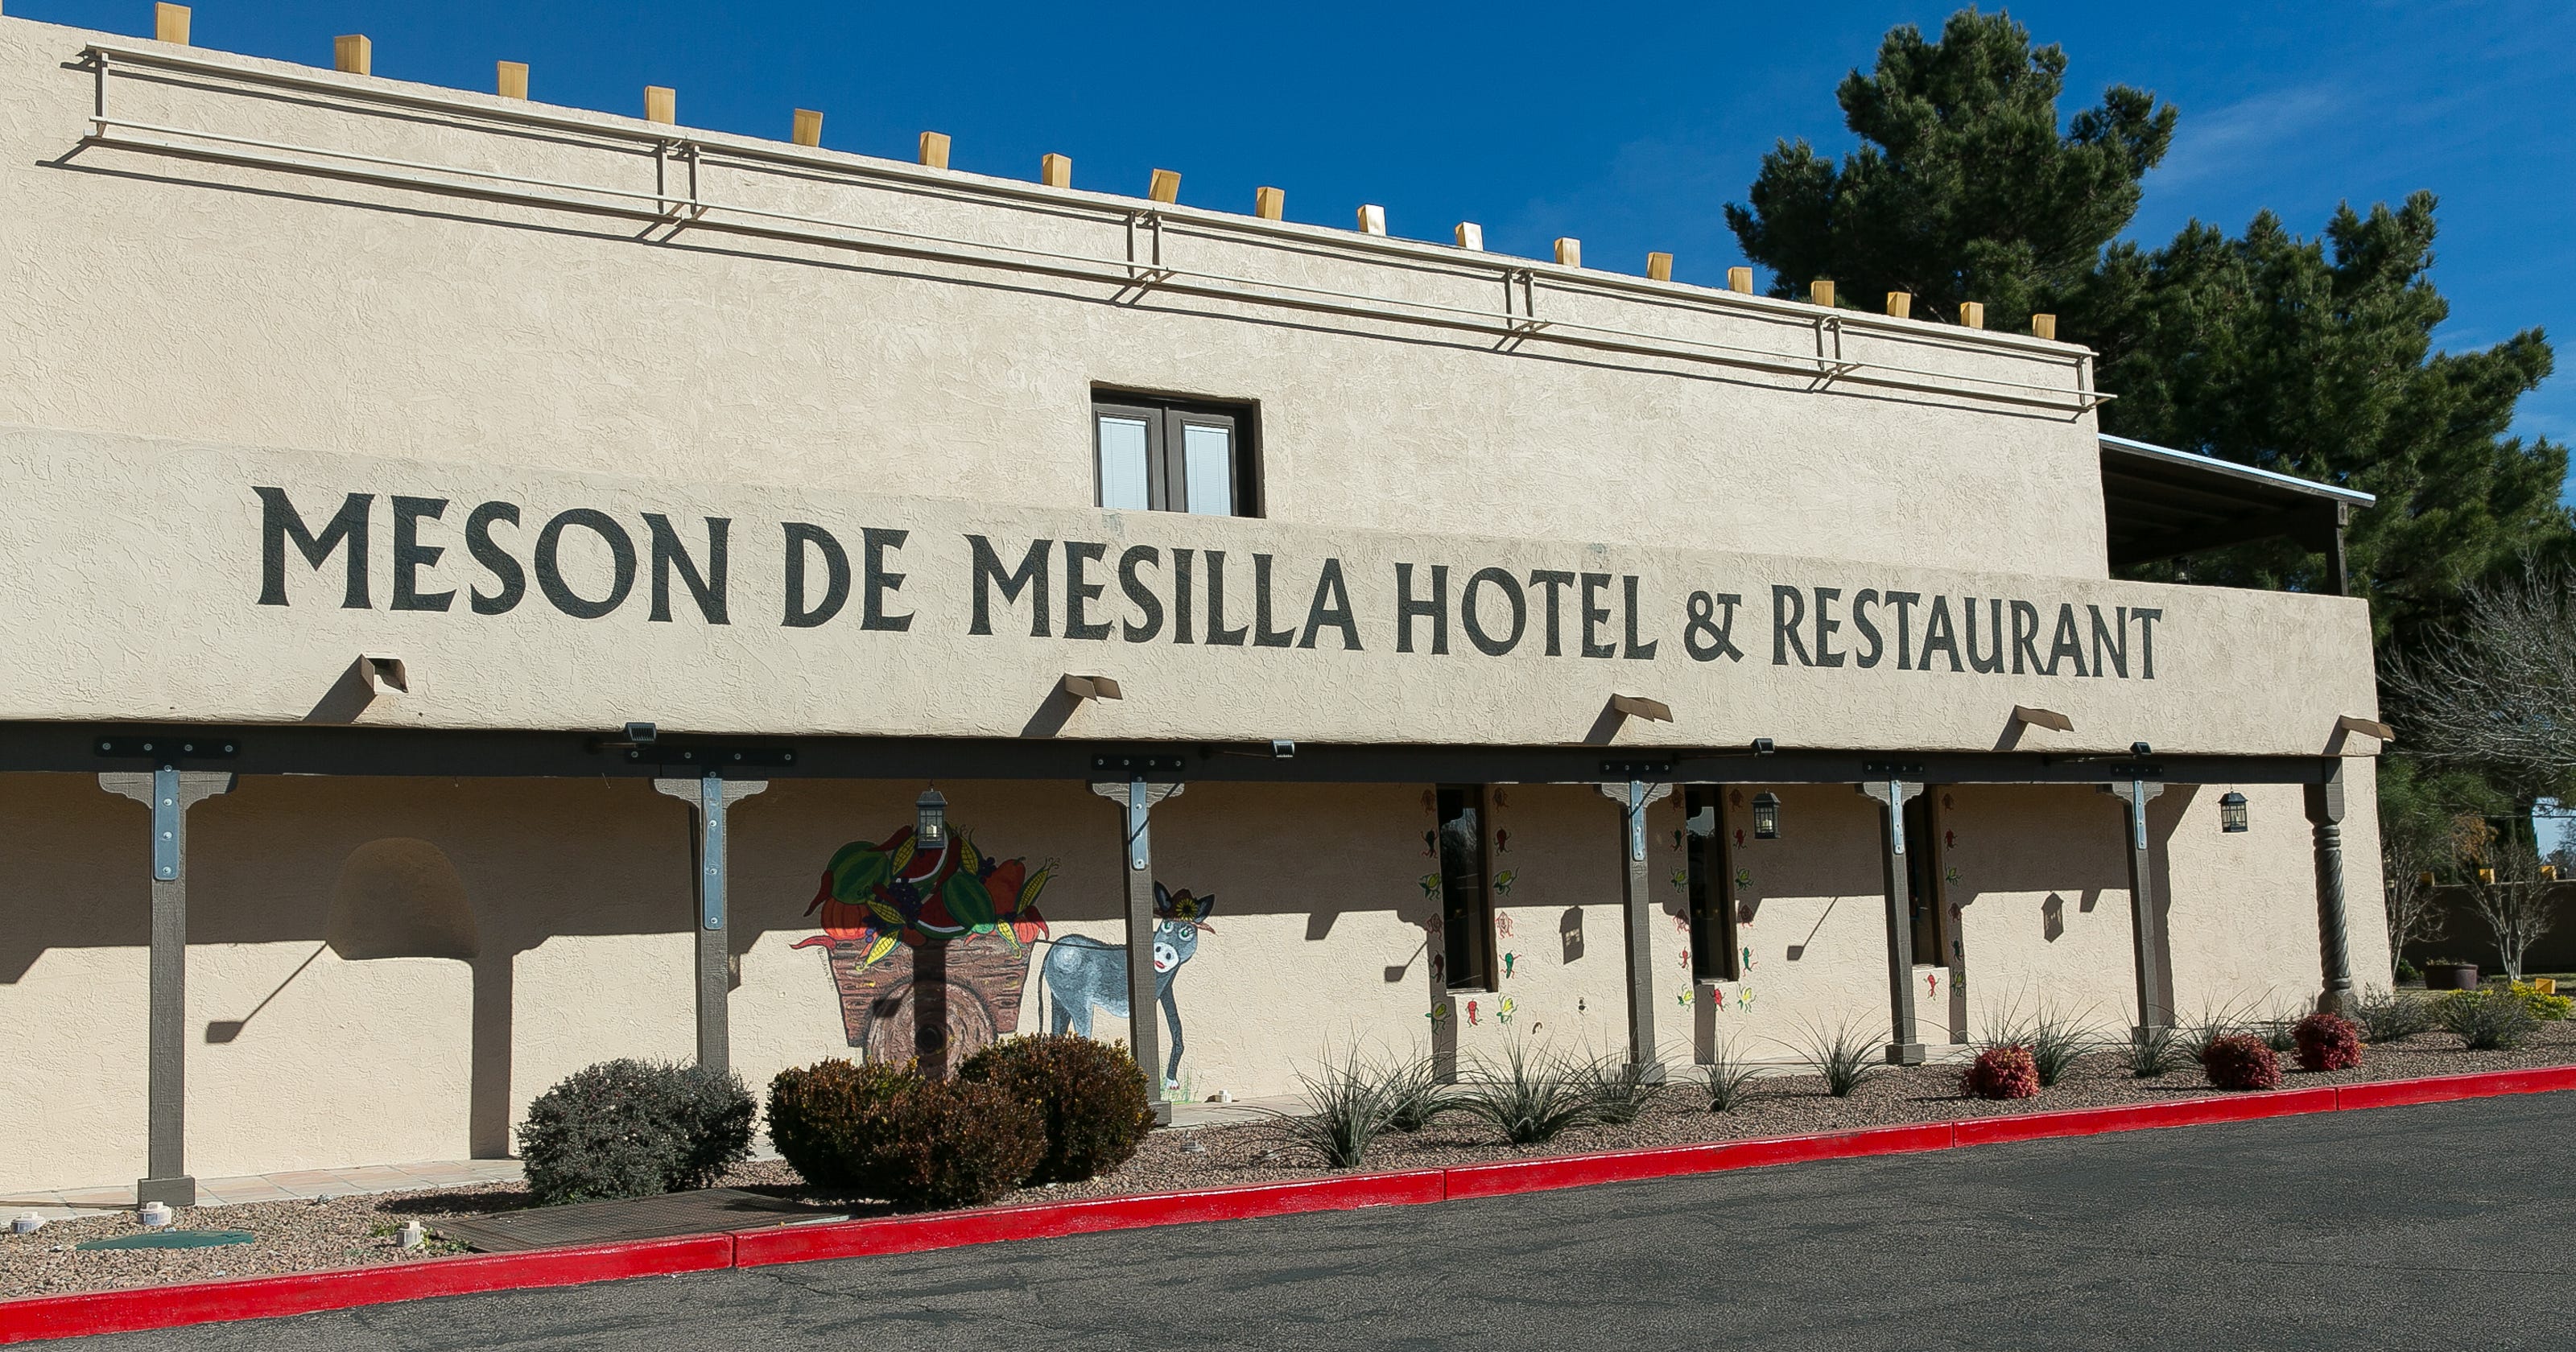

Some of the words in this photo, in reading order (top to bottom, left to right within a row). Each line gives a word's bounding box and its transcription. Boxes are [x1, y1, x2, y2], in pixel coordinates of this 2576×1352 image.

[251, 486, 732, 624] MESON
[780, 522, 915, 632] DE
[963, 534, 1364, 650] MESILLA
[1395, 563, 1658, 660] HOTEL
[1684, 591, 1744, 662] &
[1772, 585, 2162, 679] RESTAURANT
